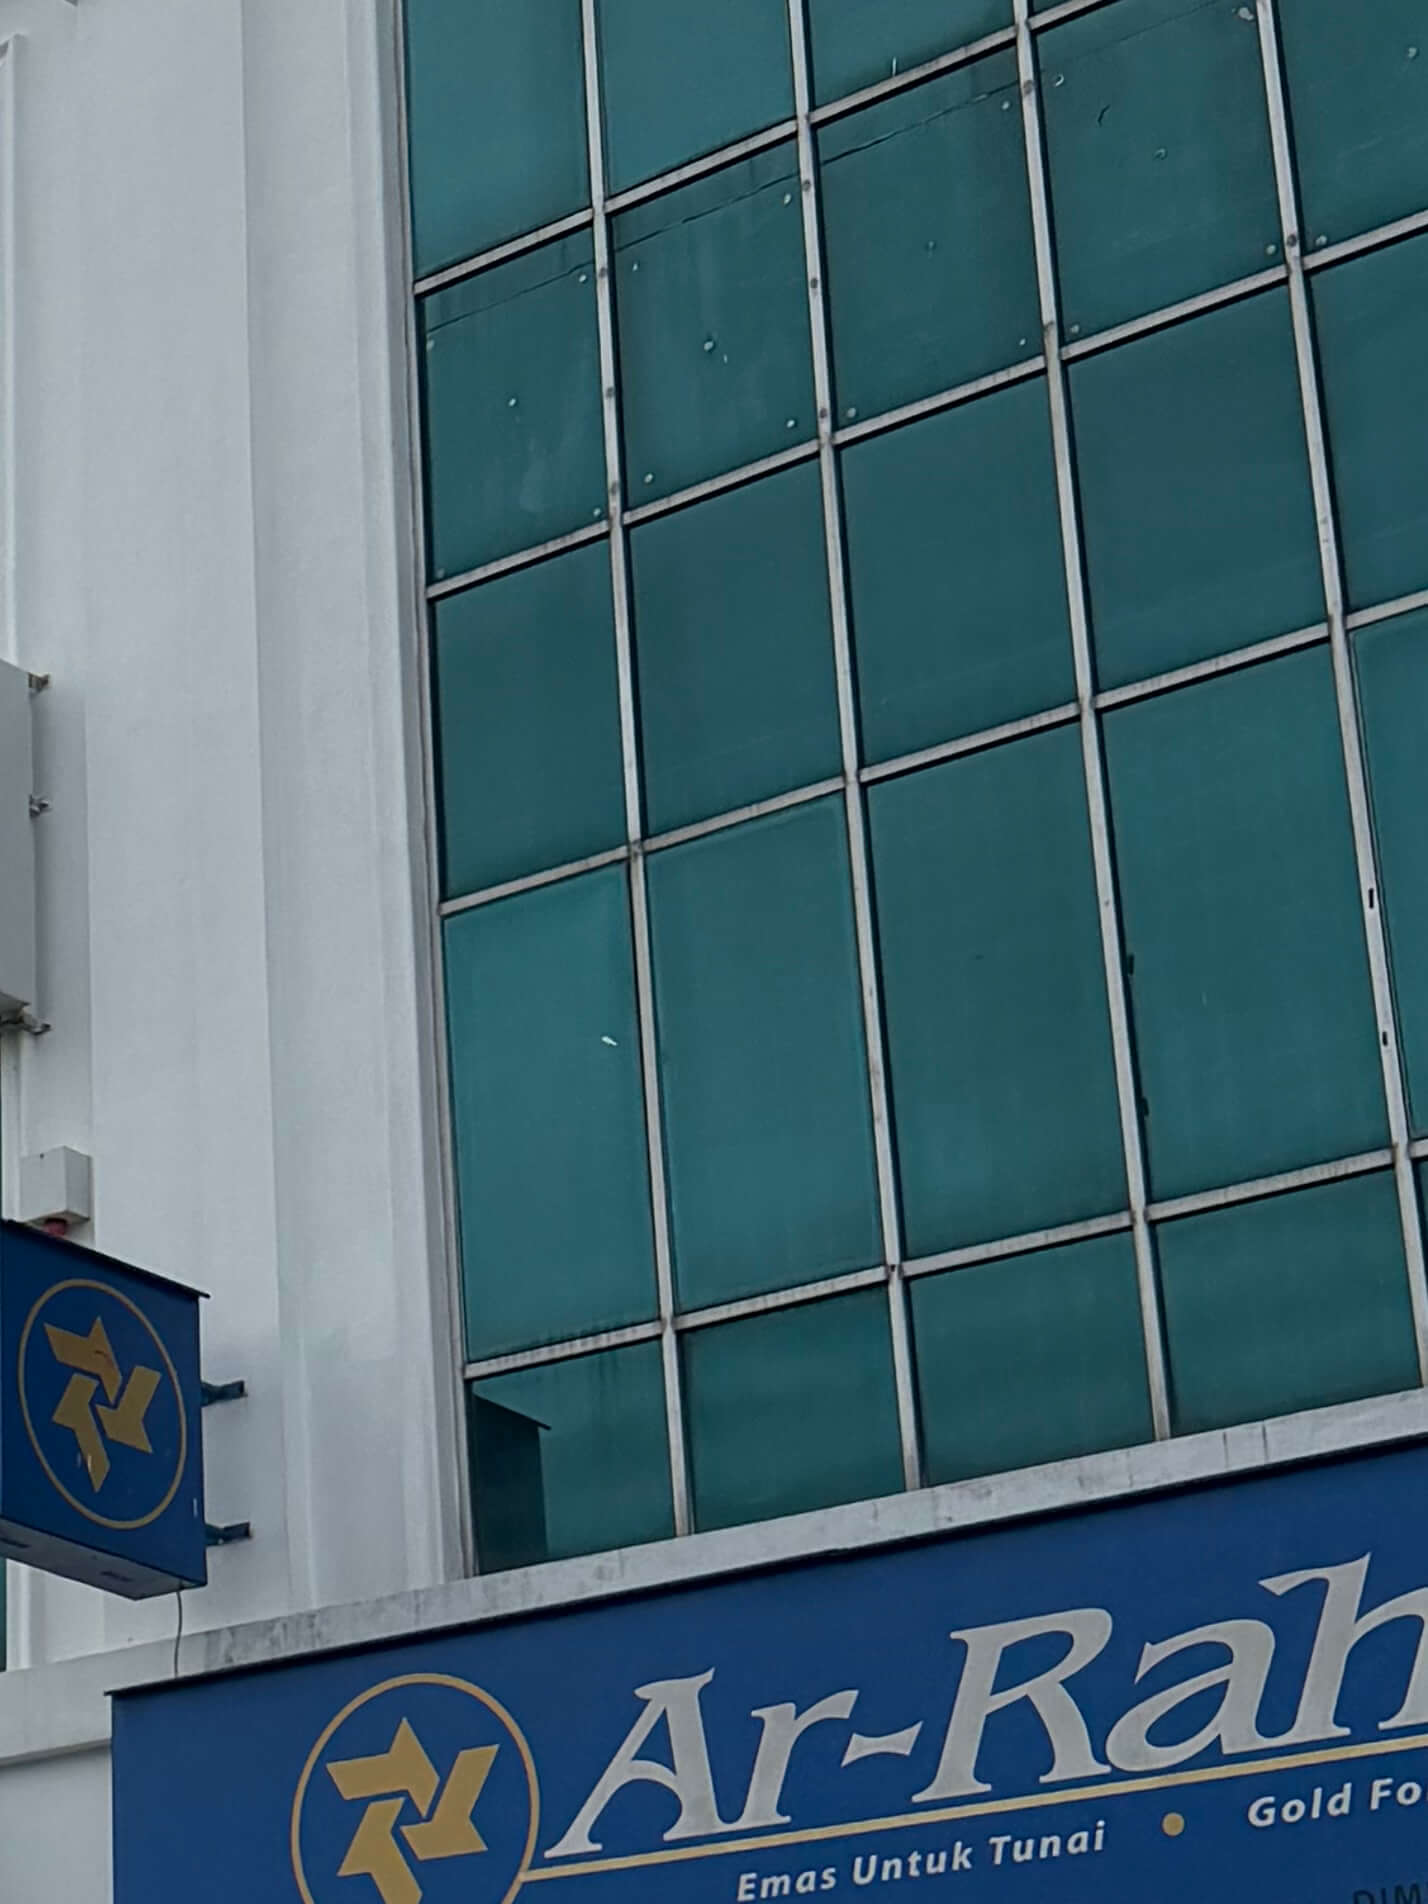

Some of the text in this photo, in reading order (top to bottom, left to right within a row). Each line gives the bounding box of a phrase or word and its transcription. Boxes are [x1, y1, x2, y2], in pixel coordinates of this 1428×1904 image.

[544, 1552, 1428, 1859] Ar-Rah
[737, 1776, 1428, 1903] Emas Untuk Tunai Gold Fo
